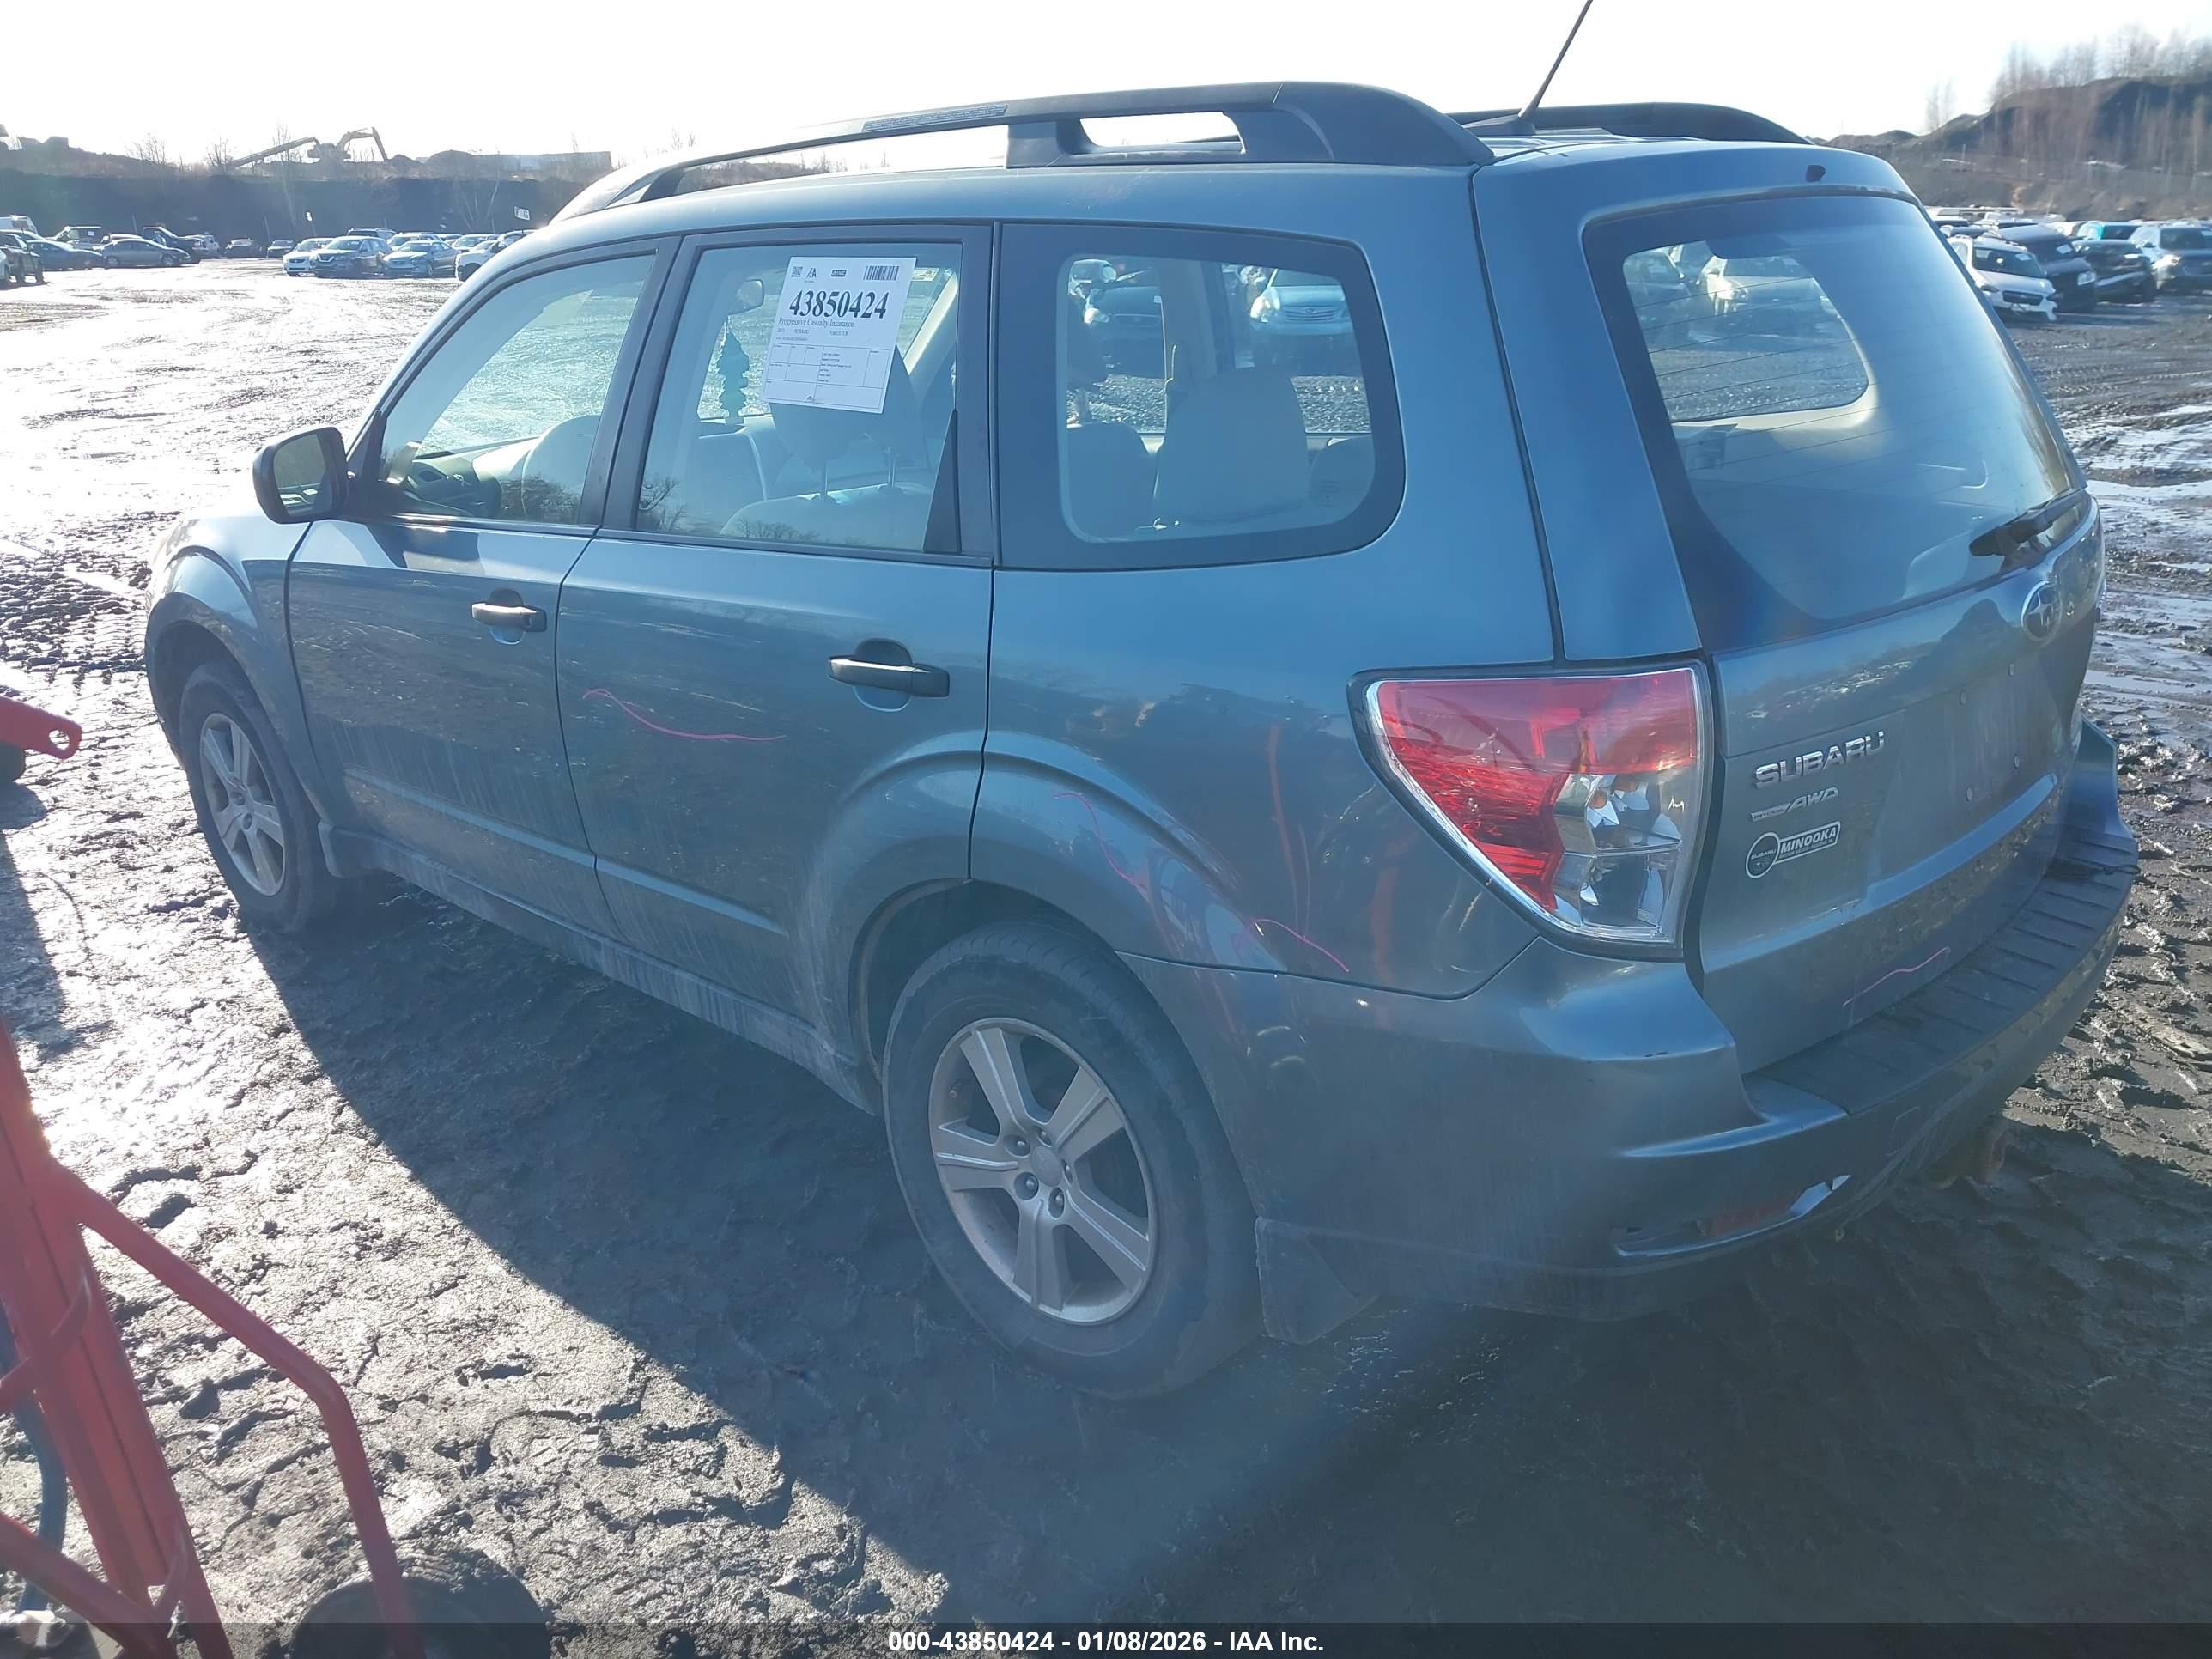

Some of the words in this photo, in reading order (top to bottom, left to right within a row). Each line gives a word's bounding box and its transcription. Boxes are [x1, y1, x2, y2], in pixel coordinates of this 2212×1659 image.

[789, 290, 890, 319] 43850424
[830, 319, 855, 328] Insurance
[1754, 731, 1885, 790] SUBARU
[1787, 787, 1839, 812] AWD
[1780, 827, 1837, 854] MINOOKA
[1751, 848, 1777, 860] SUBARU
